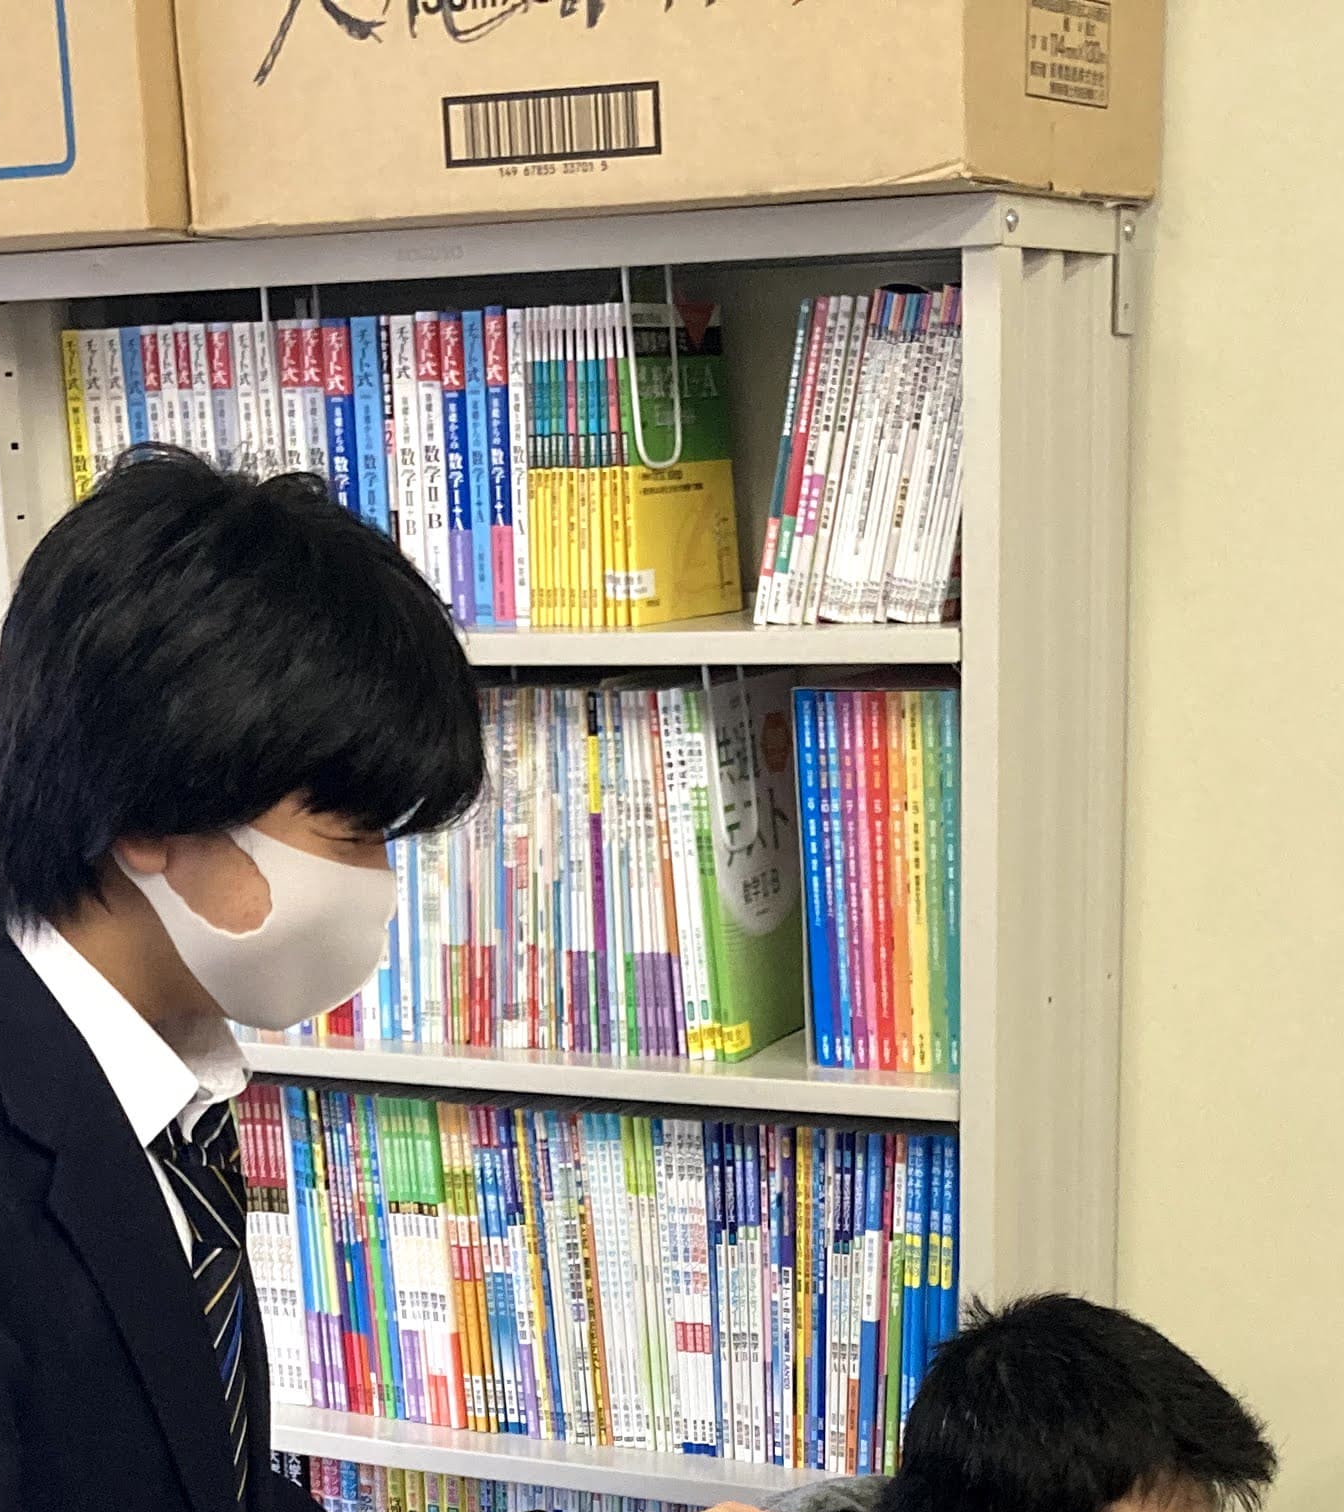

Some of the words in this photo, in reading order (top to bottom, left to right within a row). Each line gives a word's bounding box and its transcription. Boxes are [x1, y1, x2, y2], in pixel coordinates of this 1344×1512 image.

[326, 331, 346, 391] チャート式
[395, 326, 411, 380] チャート式
[418, 321, 437, 377] チャート式
[442, 325, 461, 387] チャート式
[486, 319, 505, 382] チャート式
